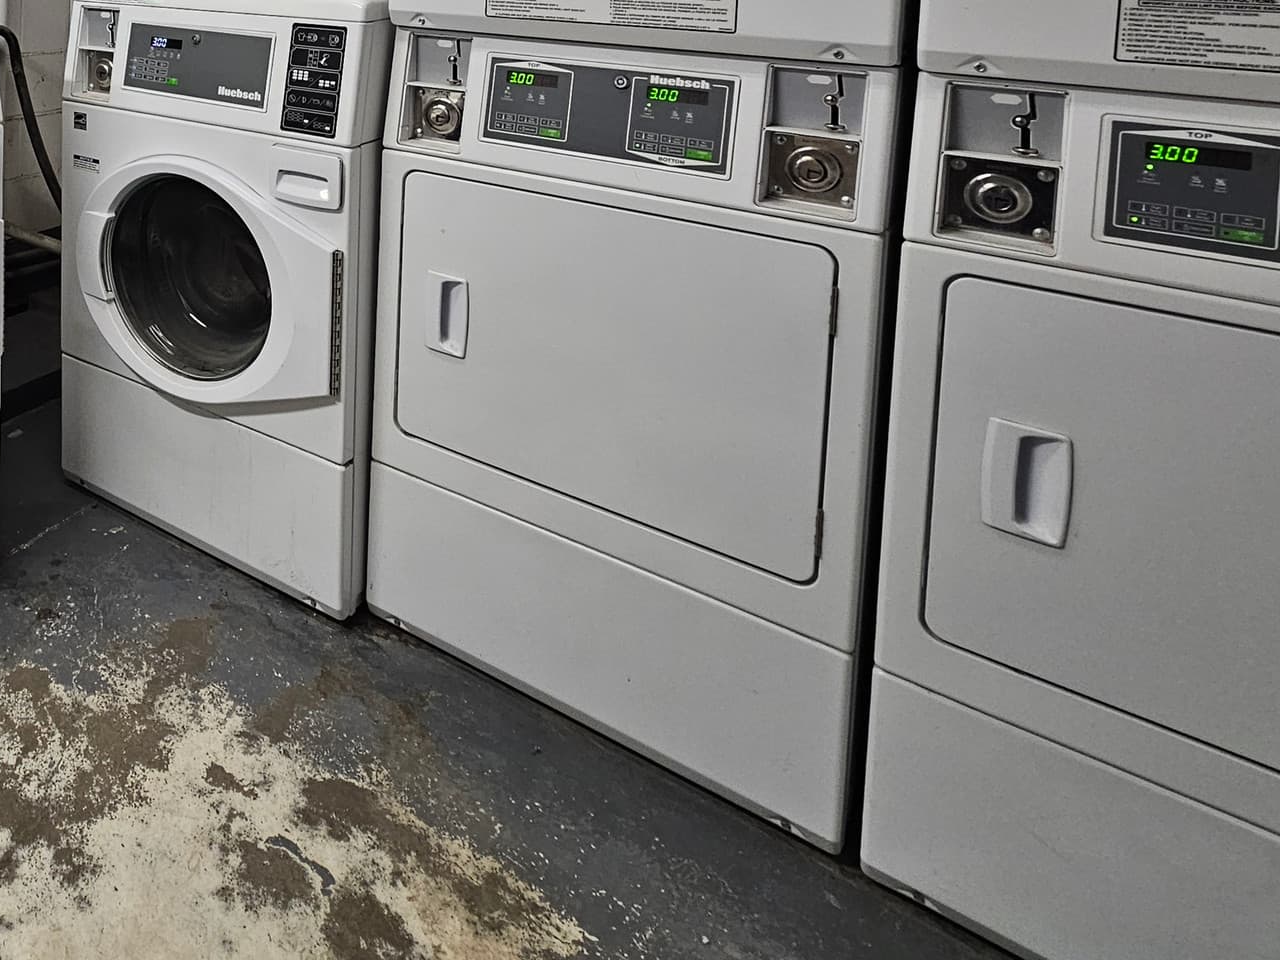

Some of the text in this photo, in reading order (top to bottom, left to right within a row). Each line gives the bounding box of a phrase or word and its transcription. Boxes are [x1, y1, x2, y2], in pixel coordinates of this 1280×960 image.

[510, 72, 535, 85] 3.00
[650, 75, 711, 90] Huebsch
[218, 85, 261, 101] Huebsch
[649, 87, 679, 102] 3.00
[1186, 131, 1213, 139] TOP
[658, 156, 685, 164] BOTTOM
[1150, 144, 1199, 163] 3.00
